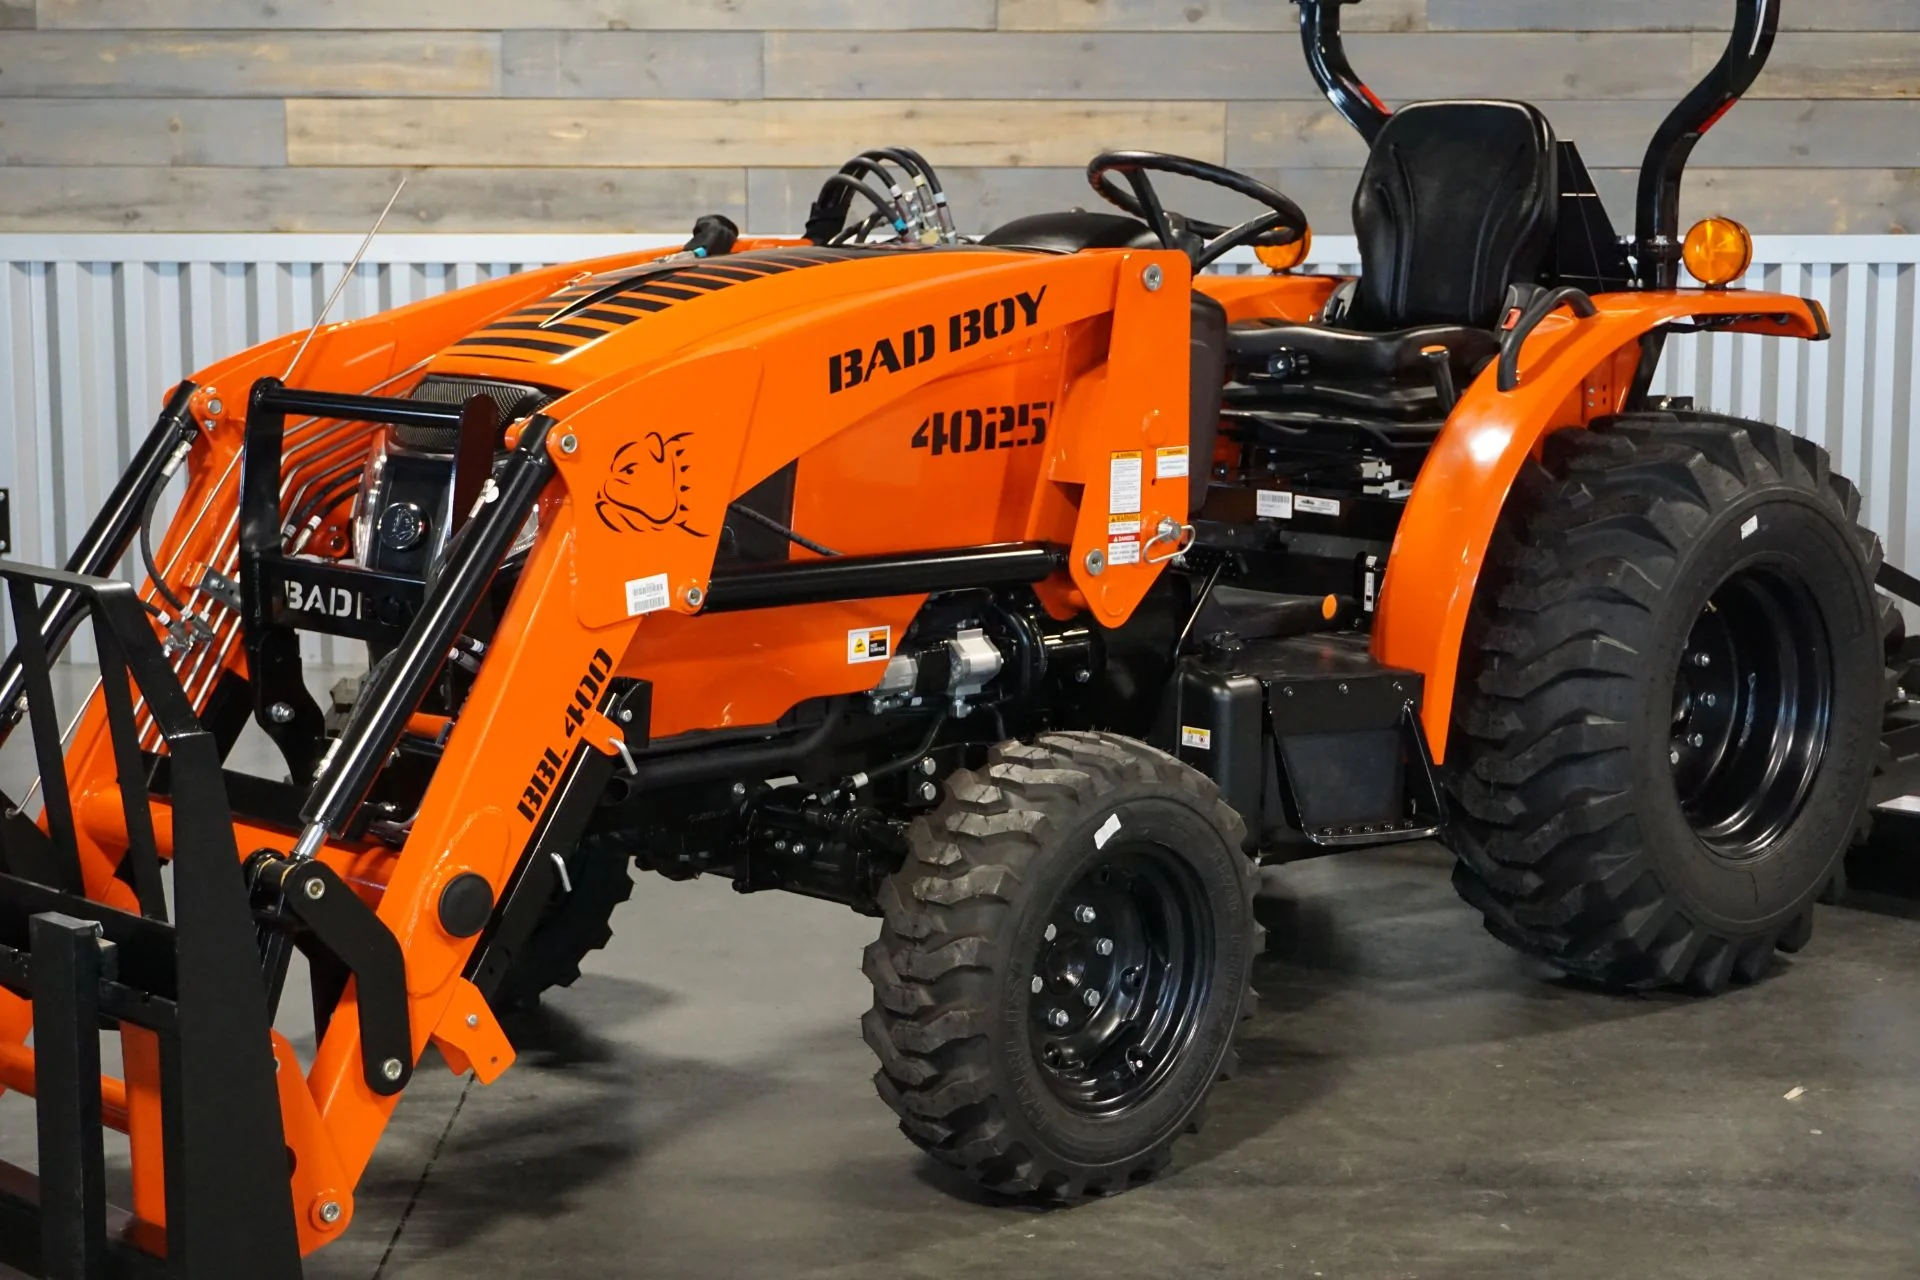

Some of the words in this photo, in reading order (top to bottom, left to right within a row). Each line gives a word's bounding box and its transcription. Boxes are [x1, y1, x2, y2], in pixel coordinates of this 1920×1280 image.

[829, 324, 936, 394] BAD
[949, 284, 1048, 353] BOY
[911, 401, 1054, 456] 4025
[284, 580, 353, 617] BAD
[516, 747, 569, 823] BBL
[565, 648, 613, 738] 400
